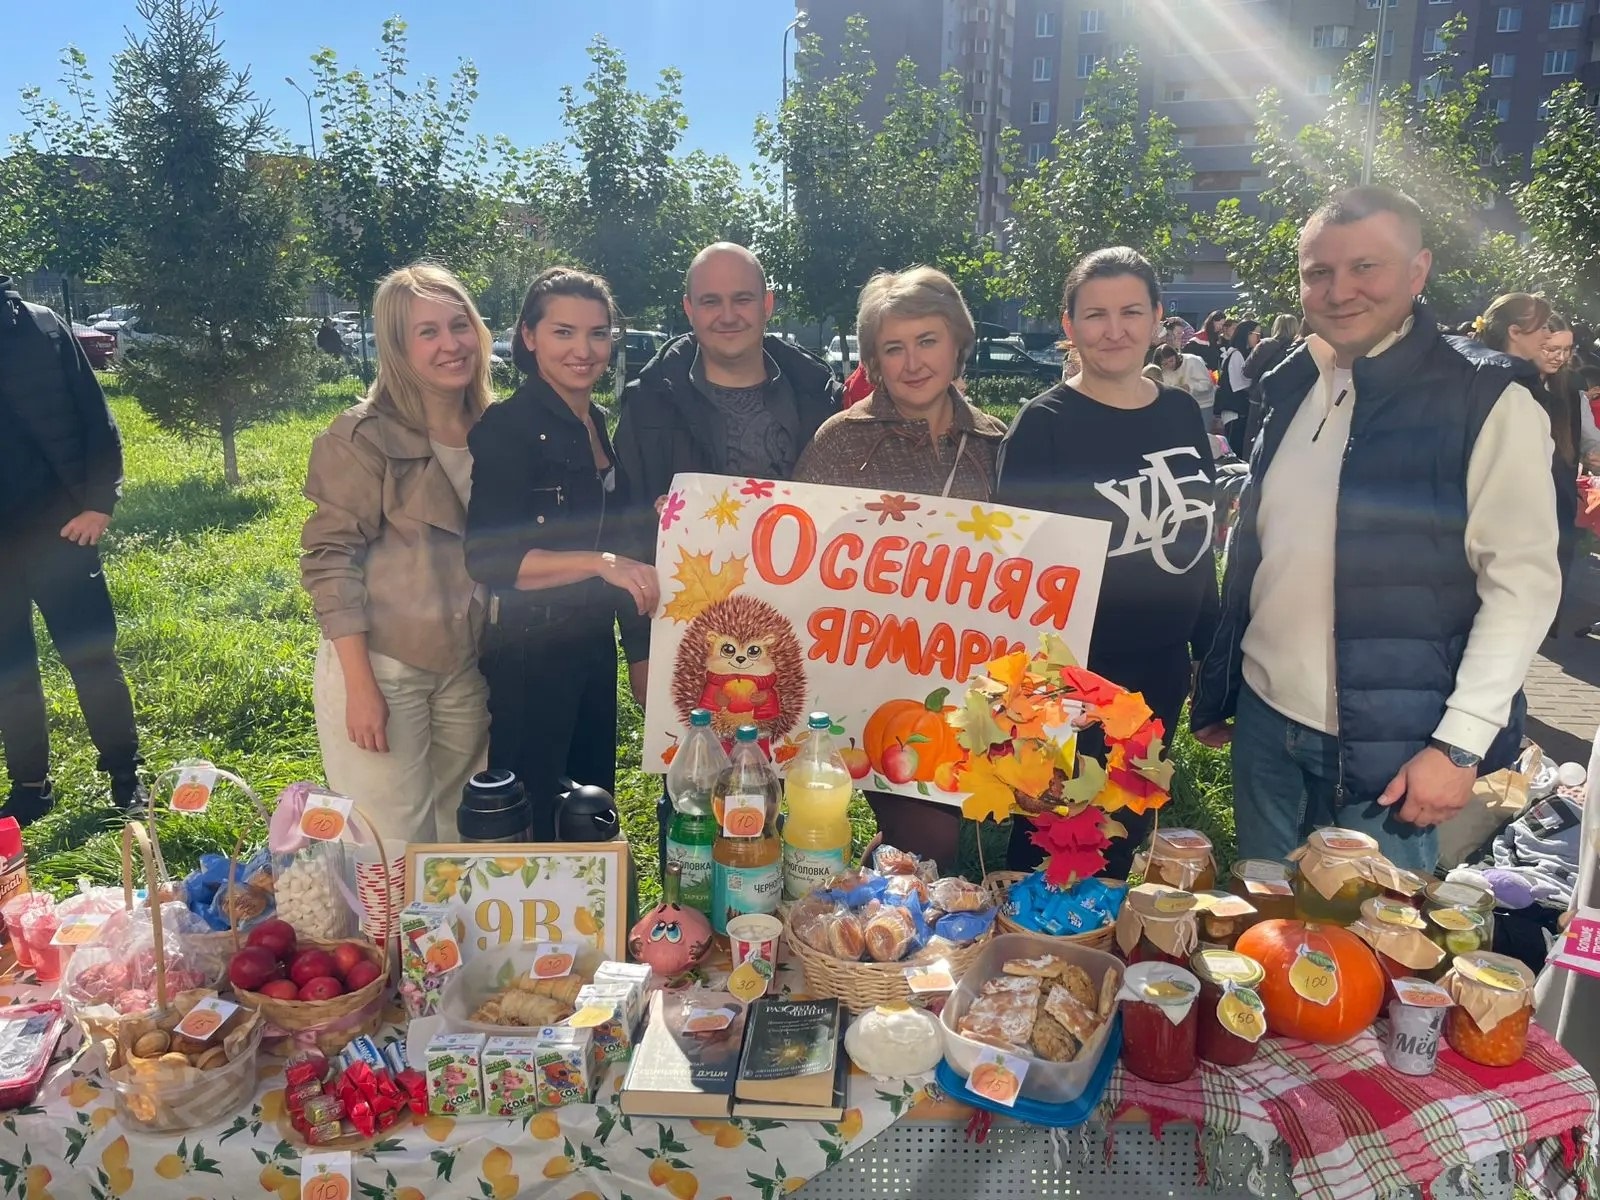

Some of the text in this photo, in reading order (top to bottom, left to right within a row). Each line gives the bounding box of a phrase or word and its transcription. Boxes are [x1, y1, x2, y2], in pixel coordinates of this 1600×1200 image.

[751, 503, 1081, 630] ОСЕННЯЯ
[806, 606, 1047, 684] ЯРМАР
[737, 815, 755, 829] 10
[736, 978, 755, 991] 30
[1303, 975, 1328, 989] 100
[1230, 1012, 1256, 1025] 150
[1395, 1032, 1437, 1060] Мёд
